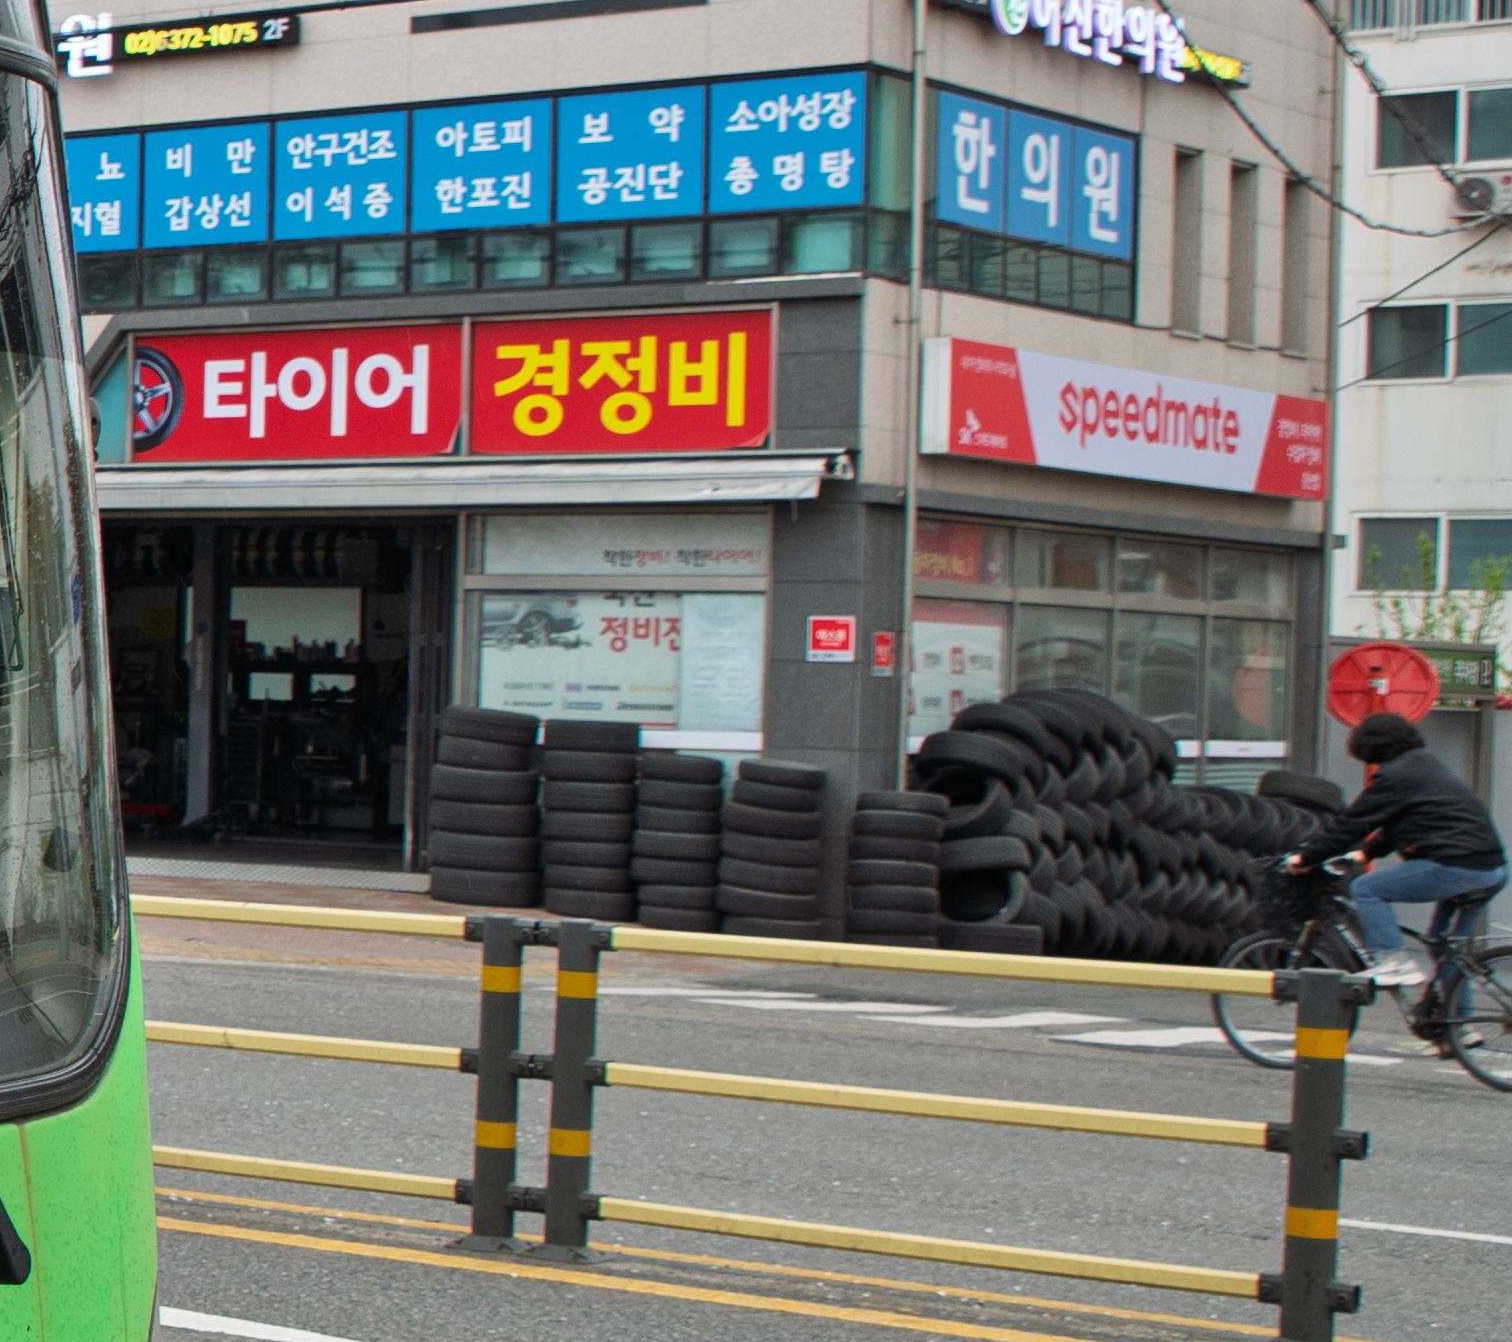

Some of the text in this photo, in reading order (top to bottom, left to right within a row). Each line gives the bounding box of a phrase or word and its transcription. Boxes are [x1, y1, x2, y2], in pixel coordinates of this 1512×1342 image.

[286, 128, 397, 171] 안구건조
[435, 114, 534, 159] 아토피
[724, 89, 857, 135] 소아성장
[165, 191, 252, 232] 갑상선
[435, 170, 533, 215] 한포진
[578, 160, 683, 206] 공진단
[201, 343, 430, 439] 타이어
[493, 331, 747, 438] 경정비
[1058, 380, 1241, 456] speedmate
